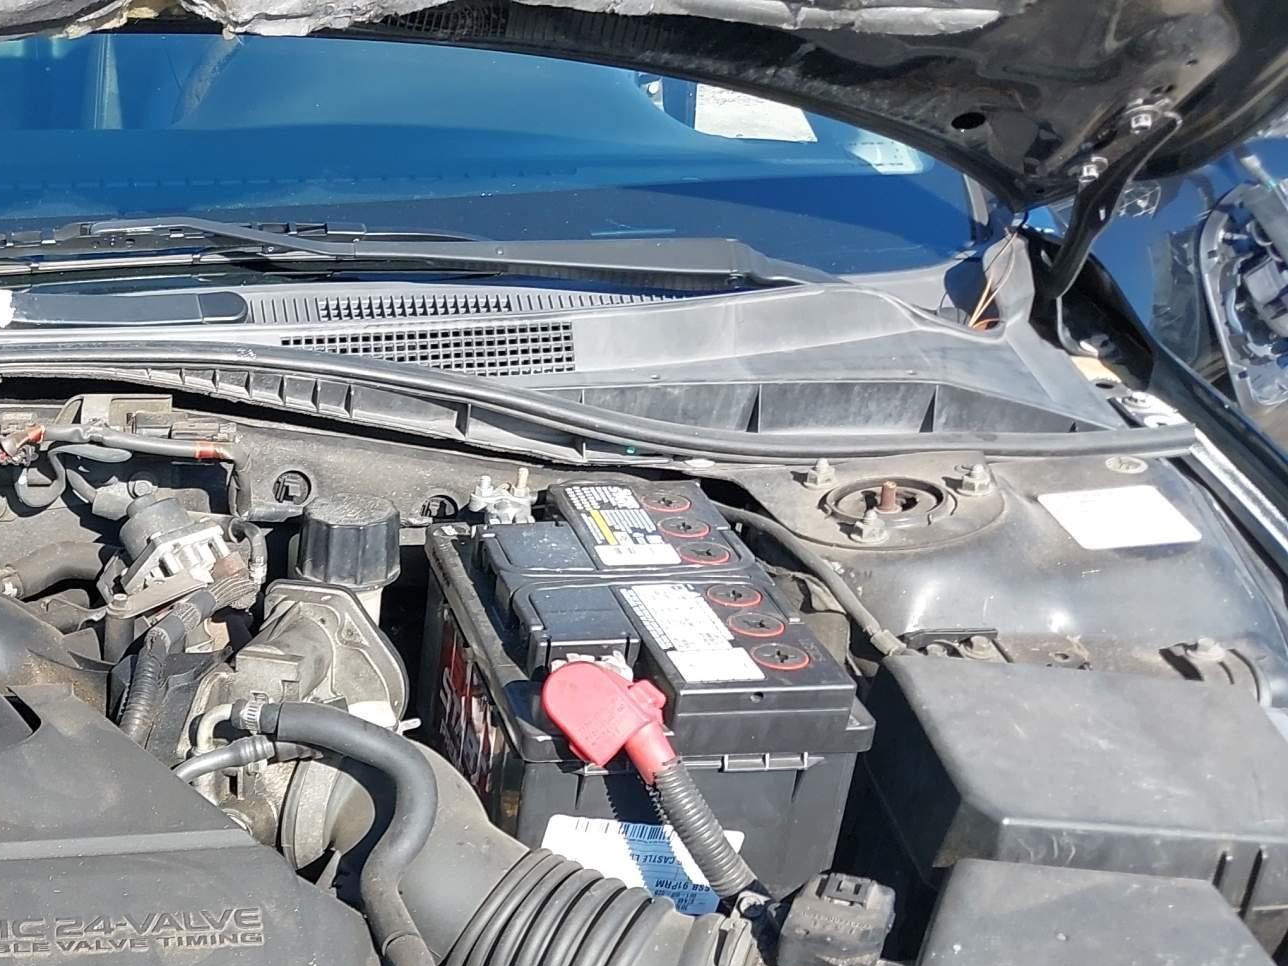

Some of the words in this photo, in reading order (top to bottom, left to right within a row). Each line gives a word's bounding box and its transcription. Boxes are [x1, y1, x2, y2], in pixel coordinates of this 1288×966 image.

[642, 854, 676, 865] CASTLE
[55, 907, 265, 937] 24-VALVE
[58, 937, 150, 954] VALVE
[157, 932, 266, 950] TIMING
